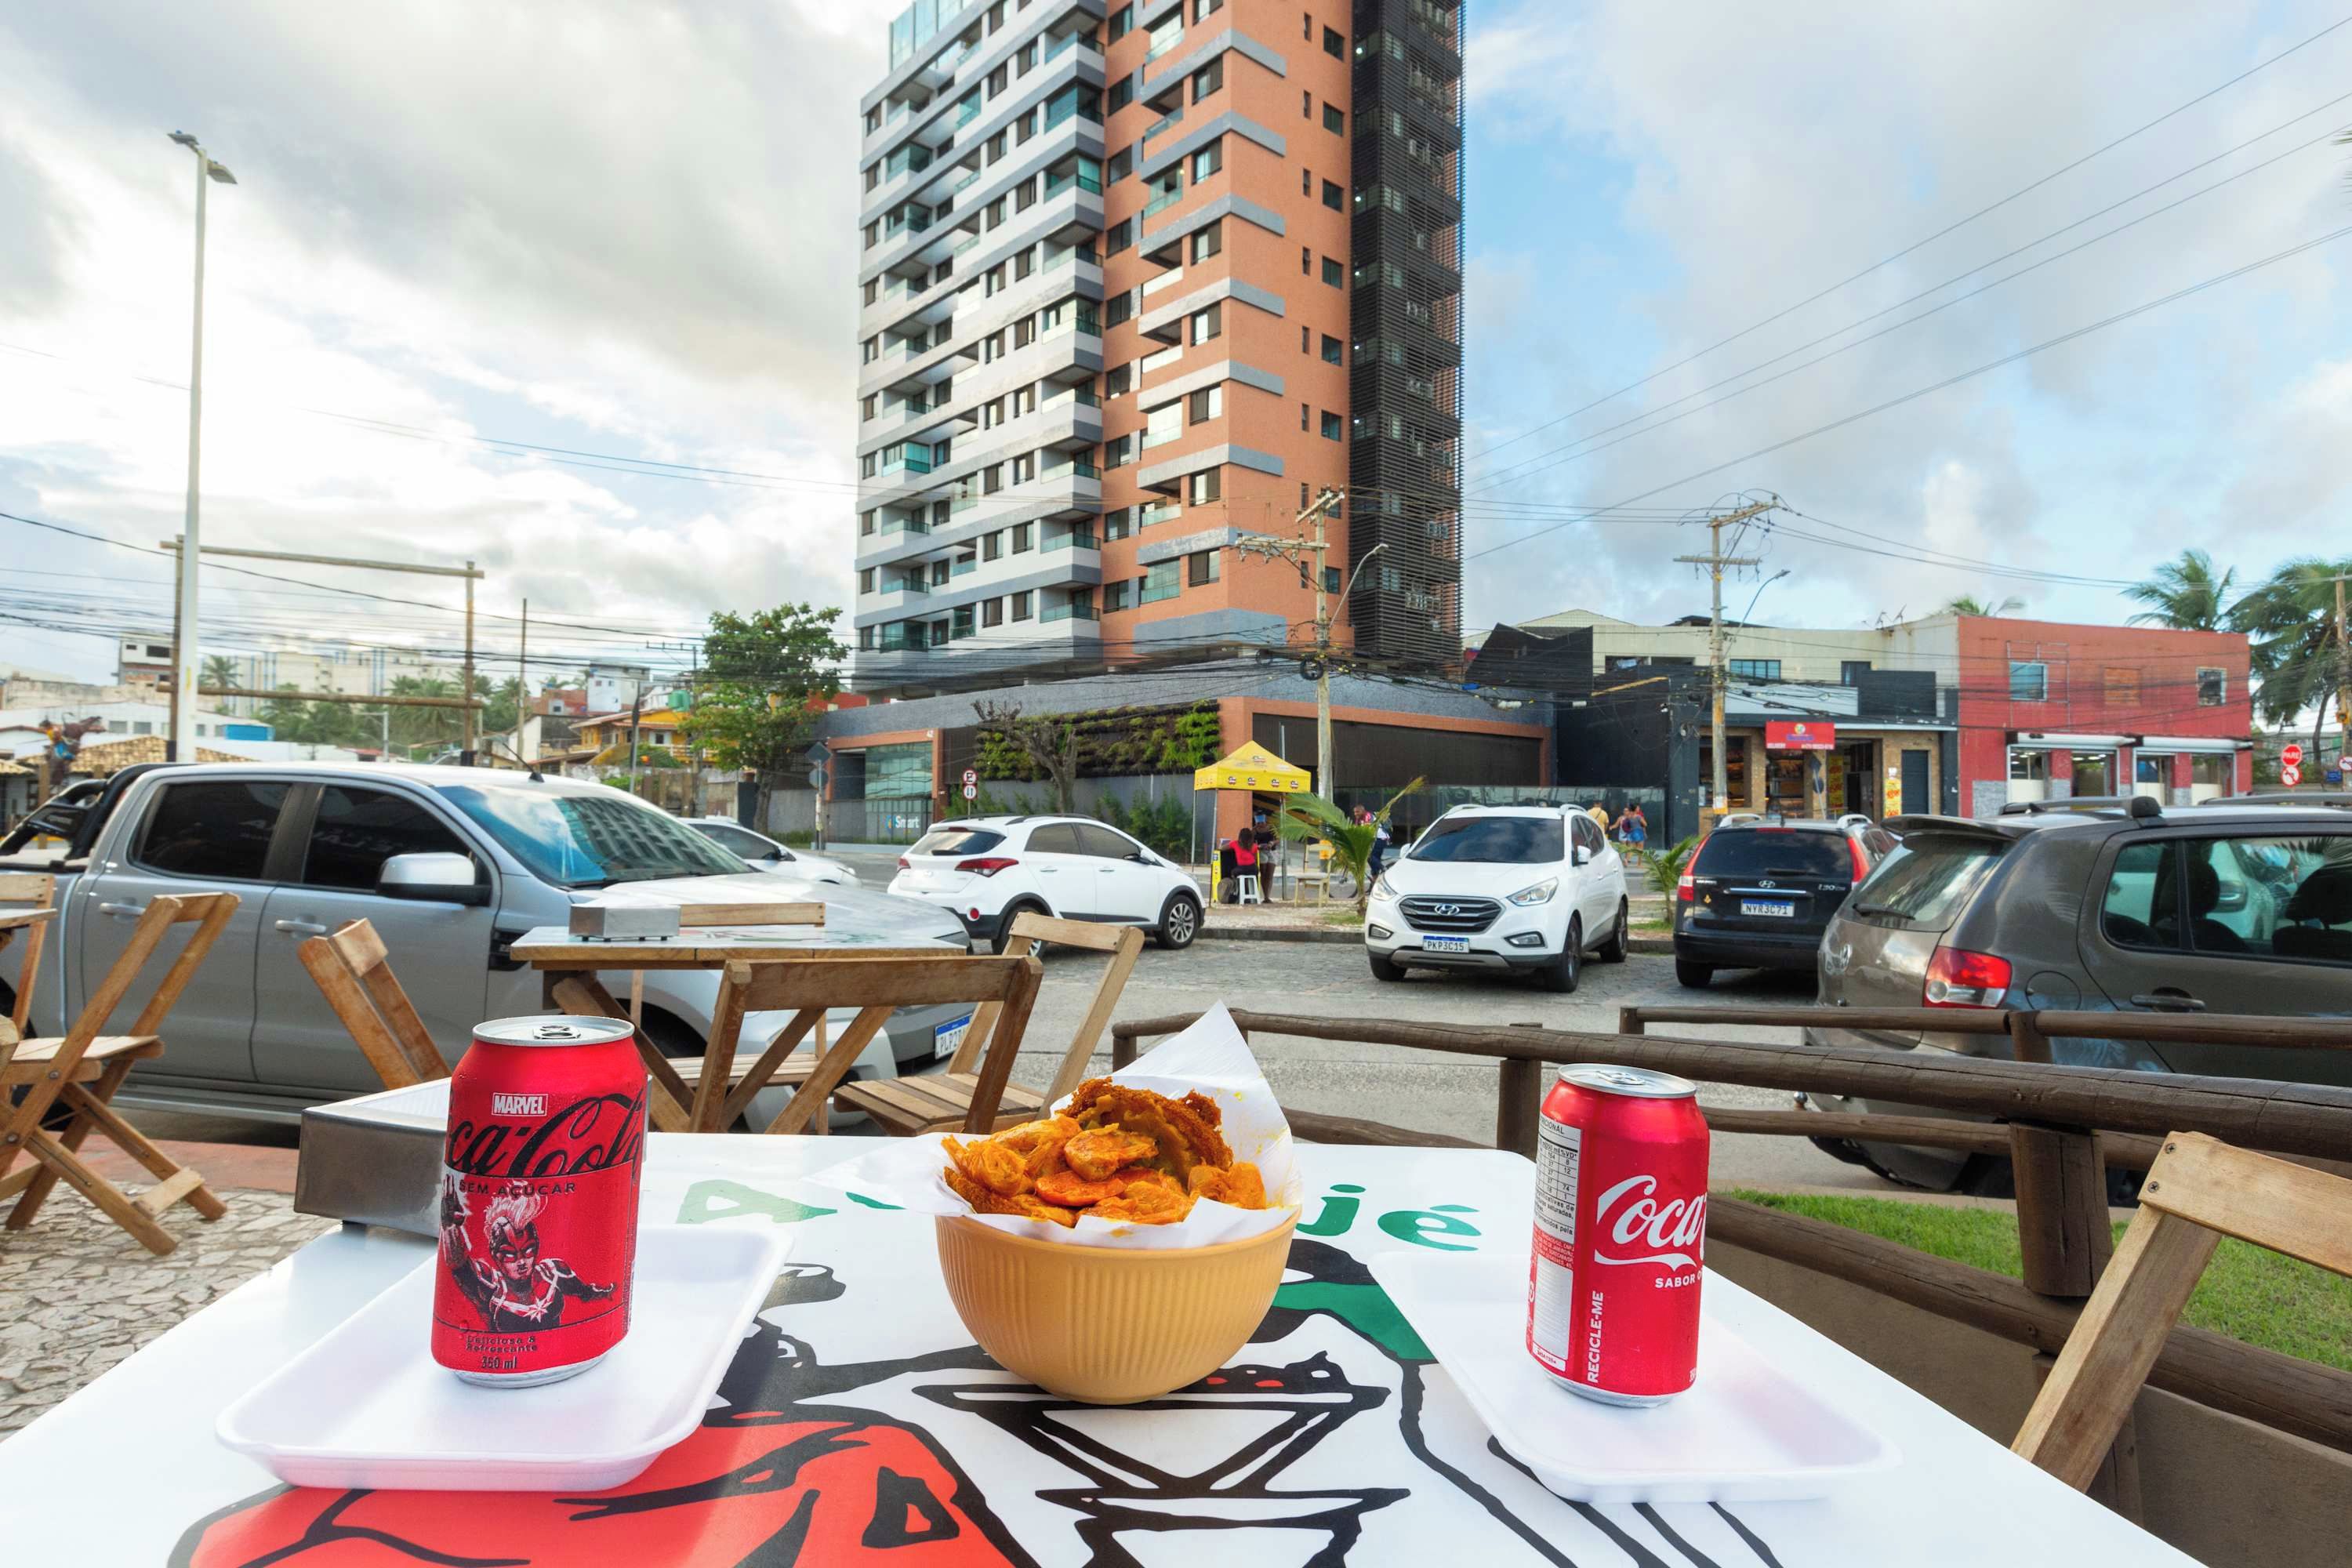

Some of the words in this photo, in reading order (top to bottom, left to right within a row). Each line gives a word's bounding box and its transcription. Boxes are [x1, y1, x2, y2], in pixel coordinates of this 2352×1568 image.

[895, 815, 920, 829] Smart
[1746, 905, 1788, 915] NYR3C71
[1427, 941, 1465, 951] PKP3C15
[493, 1094, 546, 1115] MARVEL
[459, 1178, 489, 1194] SEM
[1597, 1174, 1707, 1258] Coca
[1655, 1272, 1696, 1288] SABOR
[1587, 1290, 1604, 1383] RECICLE-ME
[503, 1356, 517, 1369] ml
